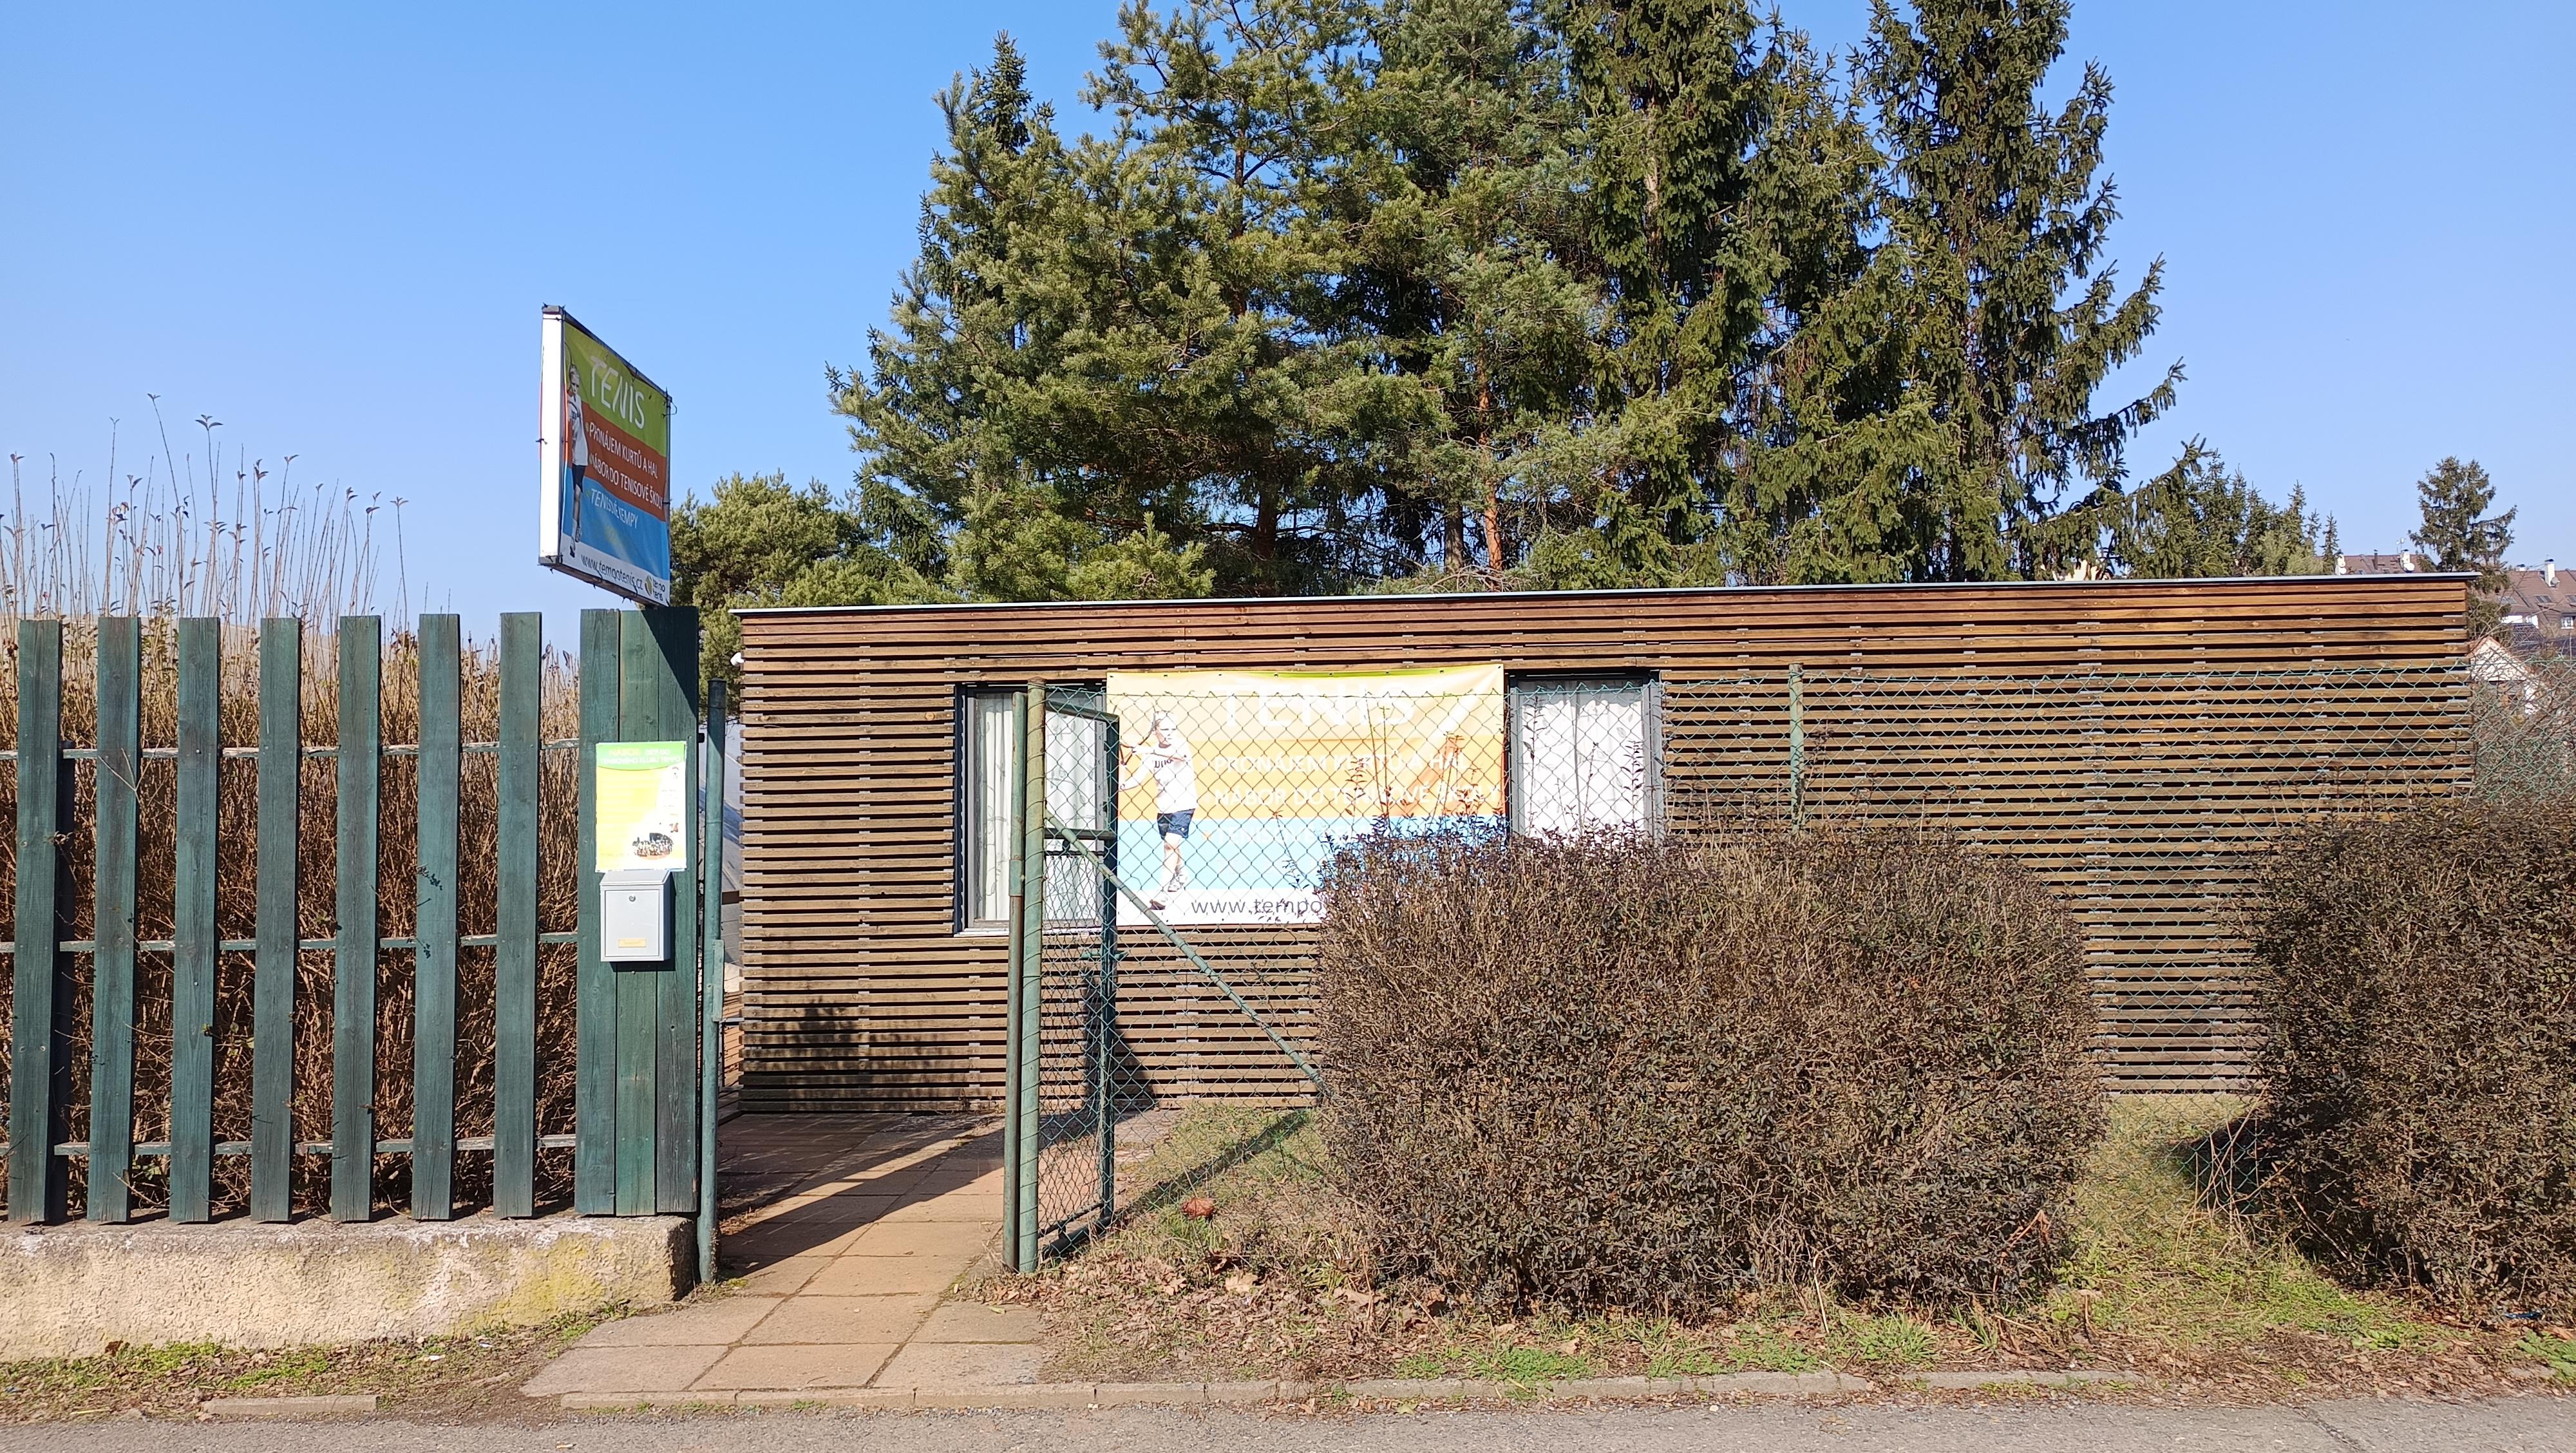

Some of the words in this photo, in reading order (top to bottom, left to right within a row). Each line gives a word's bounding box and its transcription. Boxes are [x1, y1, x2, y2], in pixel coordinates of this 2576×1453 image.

[591, 355, 645, 429] TENIS
[622, 444, 641, 469] KURTŮ
[643, 459, 647, 472] A
[648, 459, 658, 479] HAL
[611, 467, 619, 486] DO
[620, 473, 649, 502] TENISOVÉ
[649, 486, 663, 510] ŠKOLY
[1209, 682, 1415, 726] TENIS
